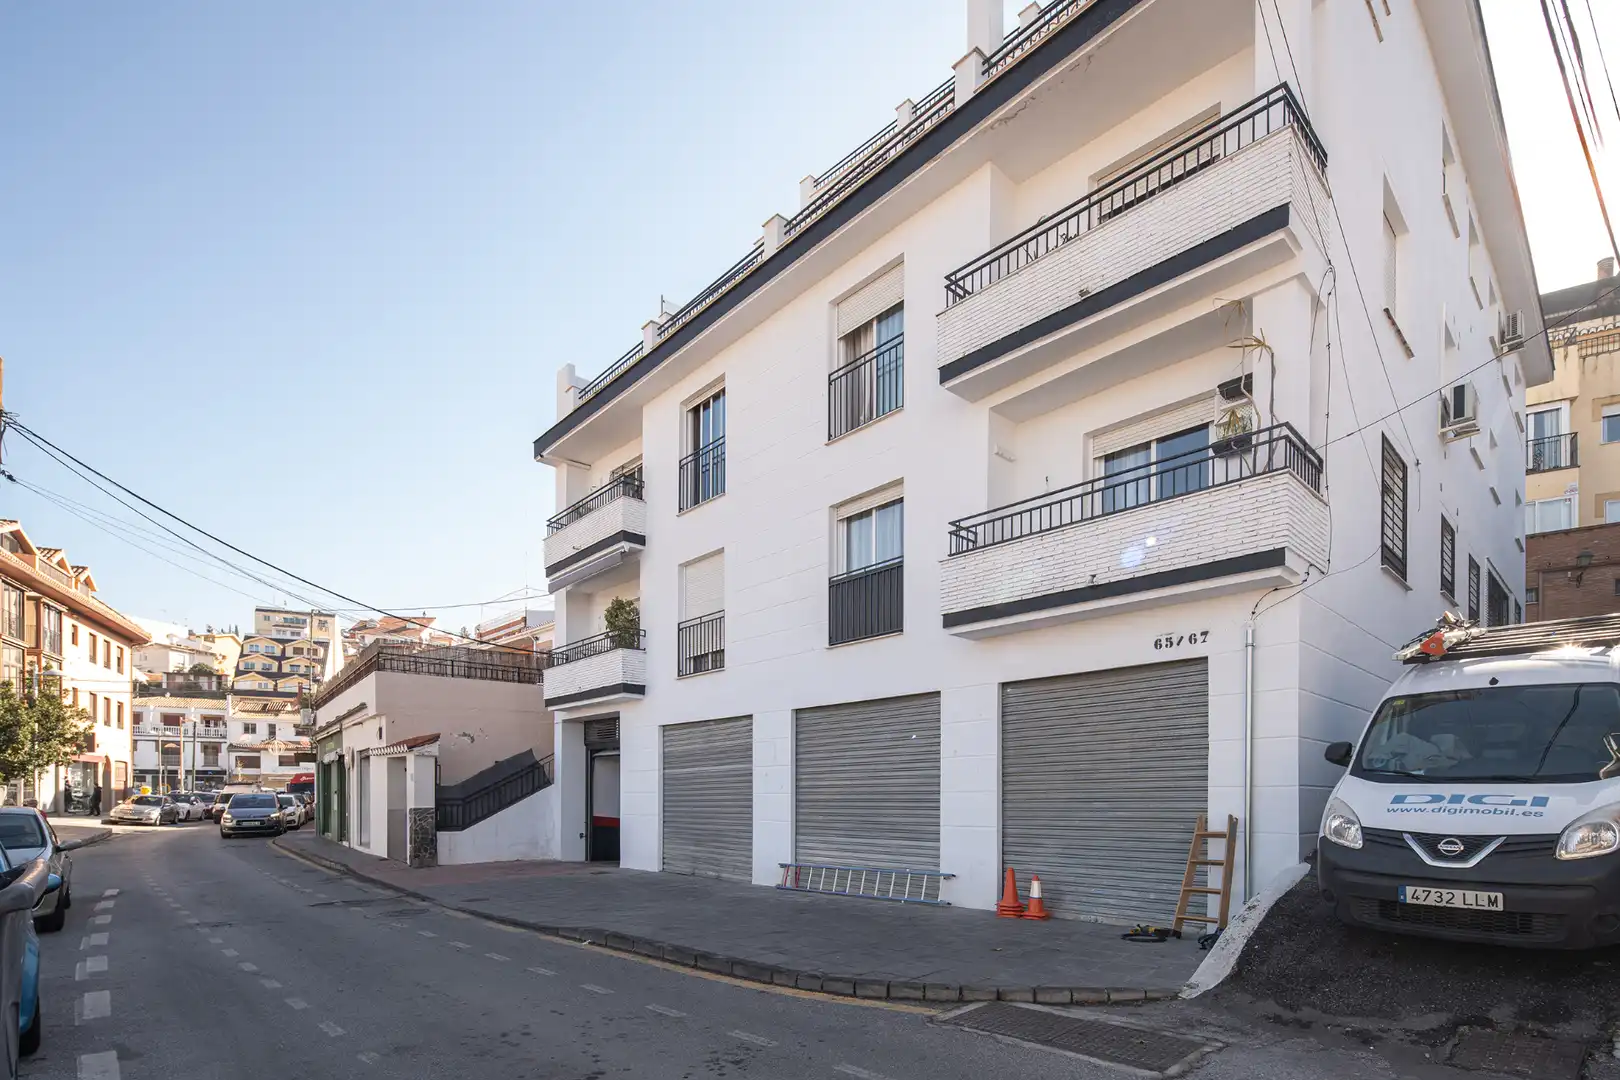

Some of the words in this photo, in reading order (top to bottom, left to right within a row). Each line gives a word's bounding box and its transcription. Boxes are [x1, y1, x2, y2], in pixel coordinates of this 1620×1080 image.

[1153, 630, 1209, 650] 65/67
[1390, 794, 1550, 808] DIGI
[1386, 806, 1544, 817] www.digimobil.es
[1411, 888, 1456, 905] 4732
[1462, 892, 1499, 908] LLM
